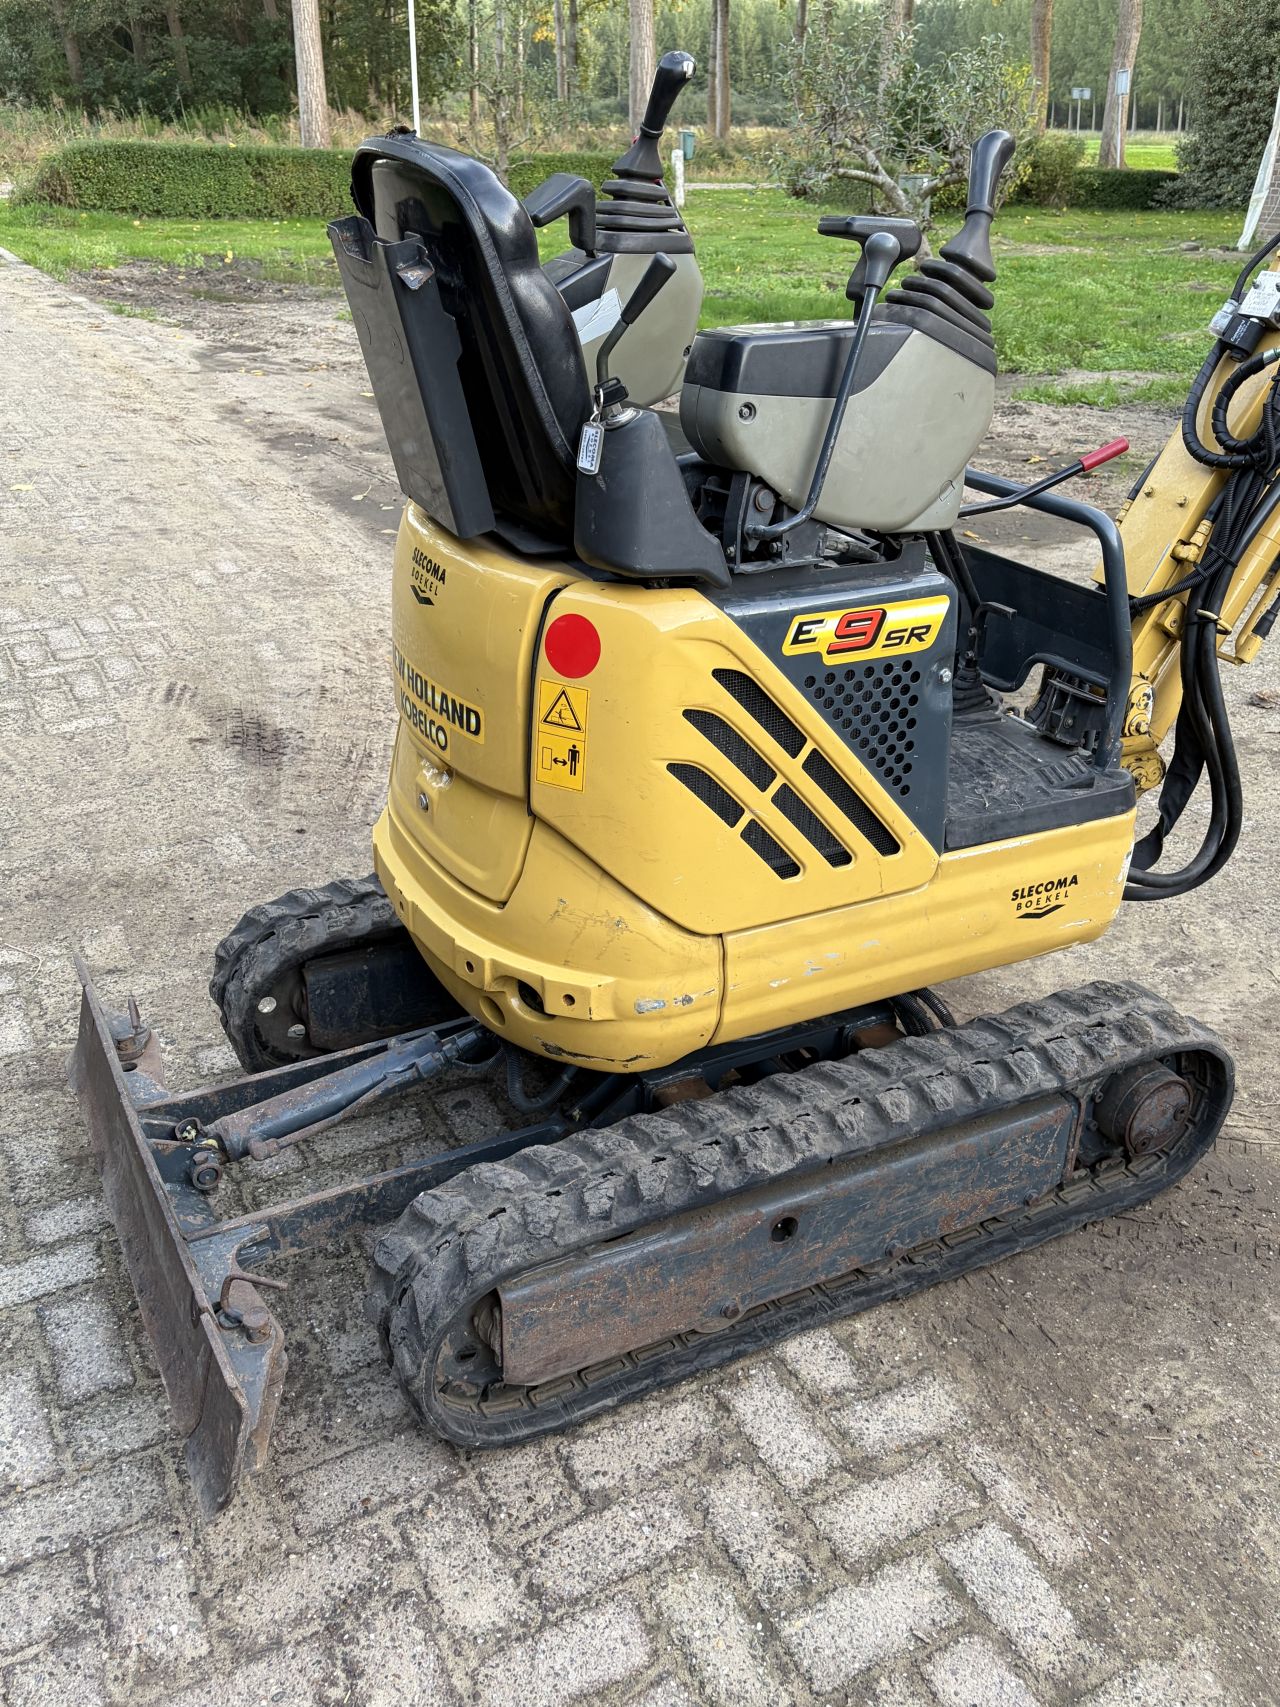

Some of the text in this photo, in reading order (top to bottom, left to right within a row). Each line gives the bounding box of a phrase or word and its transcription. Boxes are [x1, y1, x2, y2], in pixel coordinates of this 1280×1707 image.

[412, 546, 446, 585] SLECOMA
[407, 662, 481, 737] HOLLAND
[400, 687, 448, 752] KOBELCO
[1011, 874, 1078, 902] SLECOMA
[1016, 890, 1069, 912] BOEKEL
